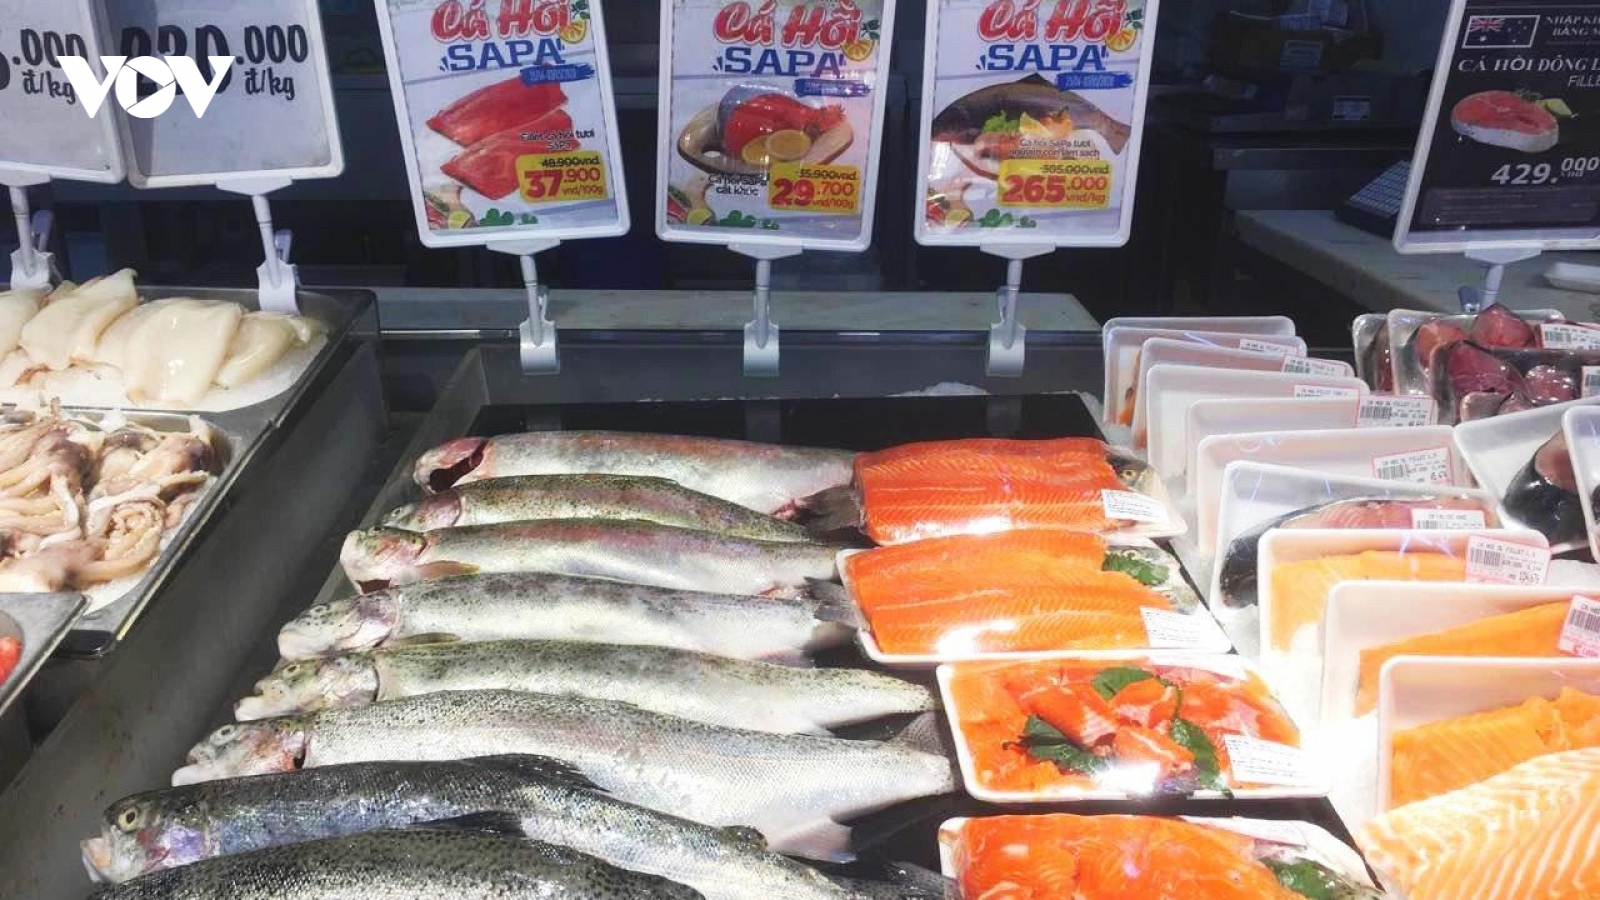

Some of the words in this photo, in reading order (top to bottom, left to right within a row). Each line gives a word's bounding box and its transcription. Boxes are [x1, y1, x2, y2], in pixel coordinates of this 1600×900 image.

[446, 39, 566, 72] SAPA
[723, 46, 841, 78] SAPA
[986, 44, 1107, 71] SAPA
[1458, 55, 1486, 71] CÁ
[1494, 53, 1534, 71] HỒI
[244, 67, 296, 100] đ/kg
[1002, 173, 1107, 203] 265.000
